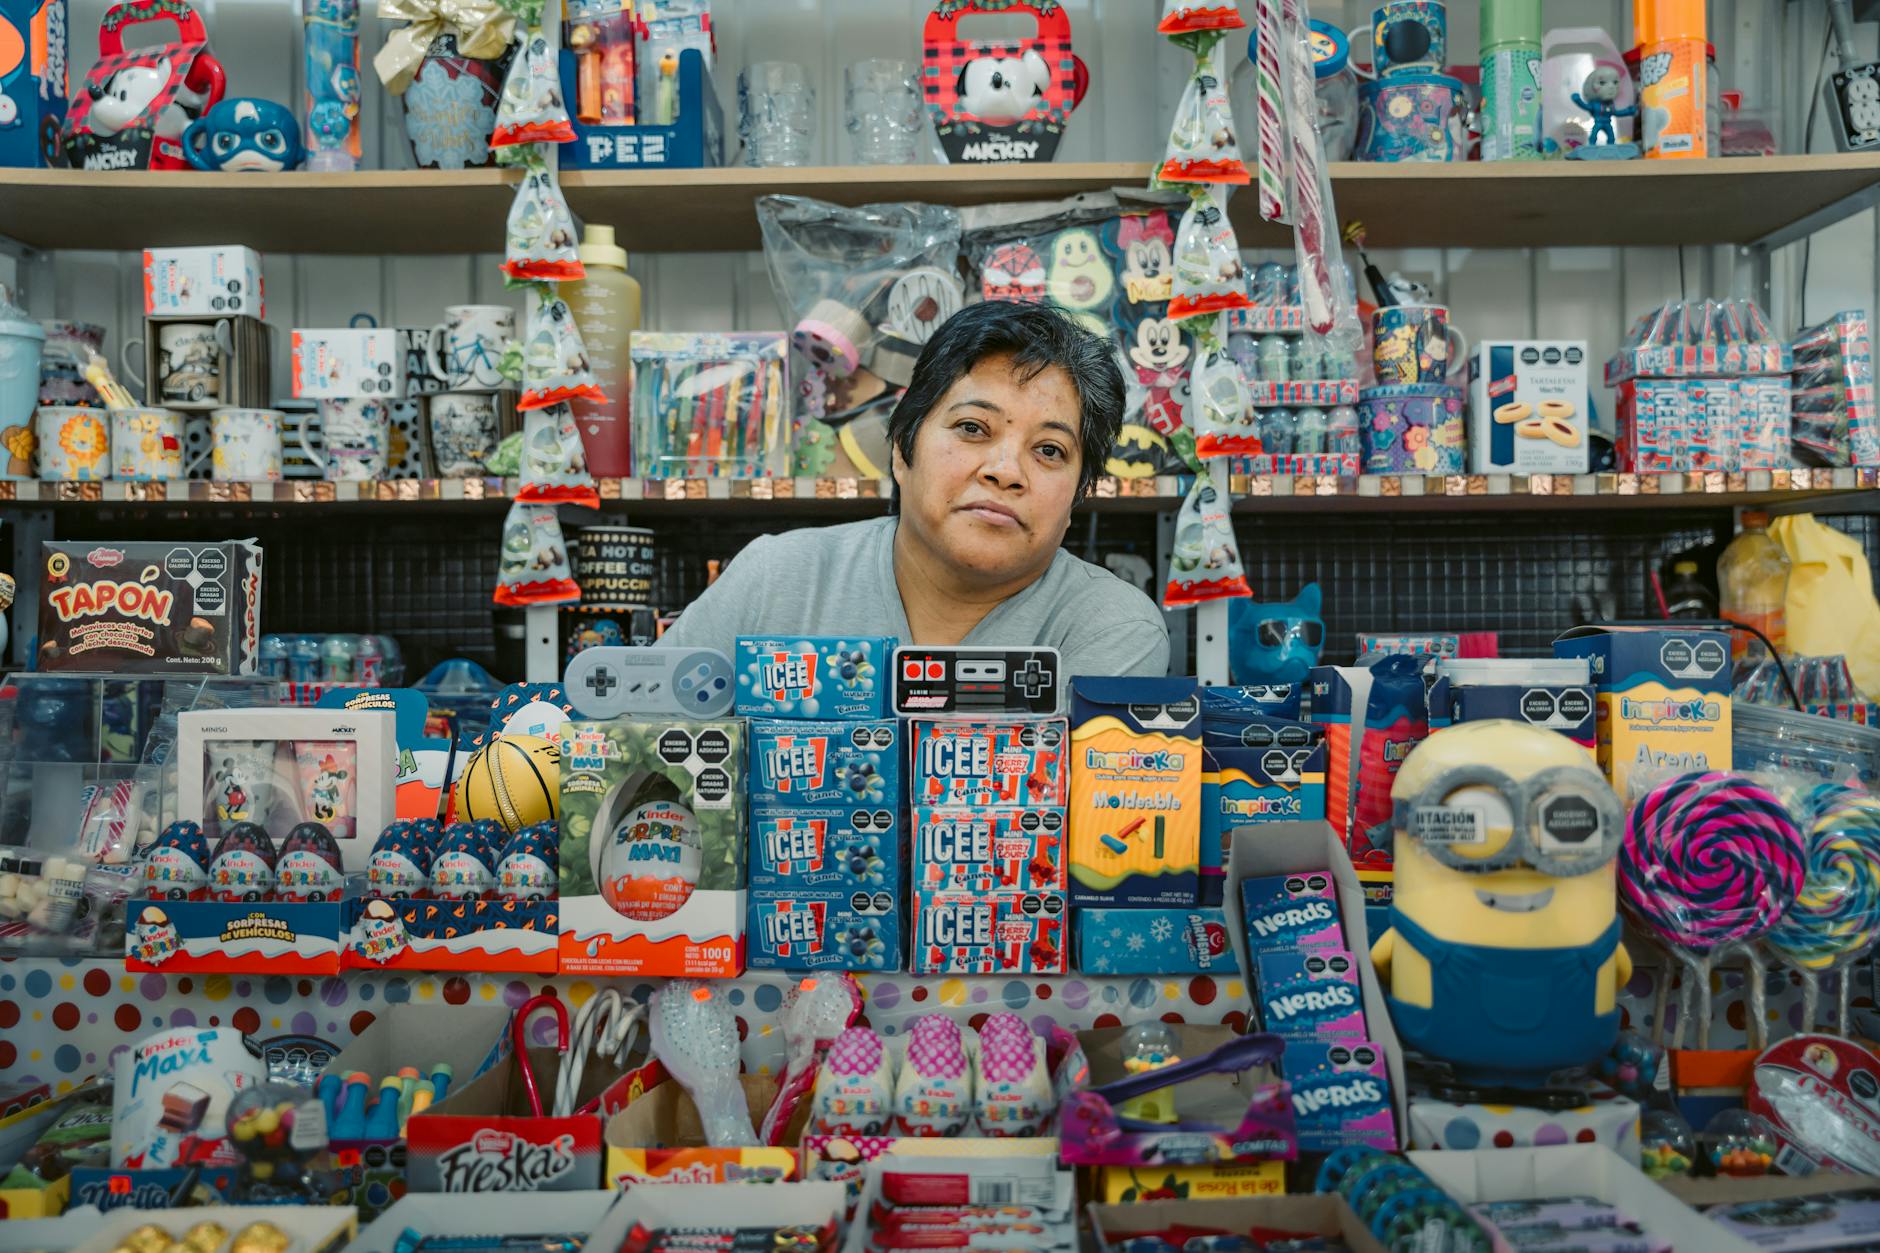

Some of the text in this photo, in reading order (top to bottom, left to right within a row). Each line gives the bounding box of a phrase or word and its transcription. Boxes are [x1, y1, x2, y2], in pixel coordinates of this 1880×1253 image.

[587, 135, 667, 163] PEZ
[961, 139, 1039, 161] MICKEY
[84, 150, 138, 171] MICKEY
[601, 545, 637, 559] HOT
[50, 566, 174, 626] TAPÓN
[69, 622, 154, 640] Malvaviscos cubiertos
[84, 630, 139, 642] con chocolate
[69, 638, 155, 657] con leche descremada
[166, 656, 222, 666] Cont. Neto: 200 g
[764, 661, 809, 690] ICEE
[575, 732, 604, 741] Kinder
[572, 757, 605, 769] MAXI
[766, 747, 819, 781] ICEE
[922, 736, 991, 779] ICEE
[1635, 744, 1710, 770] Arena
[1092, 789, 1181, 811] Moldeable
[637, 809, 687, 823] Kinder
[1552, 809, 1588, 818] EXCESO
[616, 821, 703, 850] SORPRESA
[922, 822, 991, 864] ICEE
[628, 843, 682, 863] MAXI
[766, 829, 820, 863] ICEE
[996, 843, 1029, 851] CHERRY
[220, 857, 255, 869] Kinder
[283, 858, 317, 869] Kinder
[372, 857, 402, 868] Kinder
[173, 889, 181, 898] 3
[227, 918, 288, 931] SORPRESAS
[1004, 913, 1025, 921] MINI
[220, 926, 296, 942] DE VEHÍCULOS!
[365, 924, 397, 939] Kinder
[766, 911, 820, 945] ICEE
[924, 906, 993, 947] ICEE
[996, 927, 1031, 935] CHERRY
[140, 928, 169, 943] Kinder
[1188, 914, 1211, 969] AIRHEADS
[702, 947, 731, 962] 100 g
[133, 1033, 194, 1064] Kinder
[131, 1041, 213, 1098] Maxi
[1232, 1140, 1288, 1154] GOMITAS
